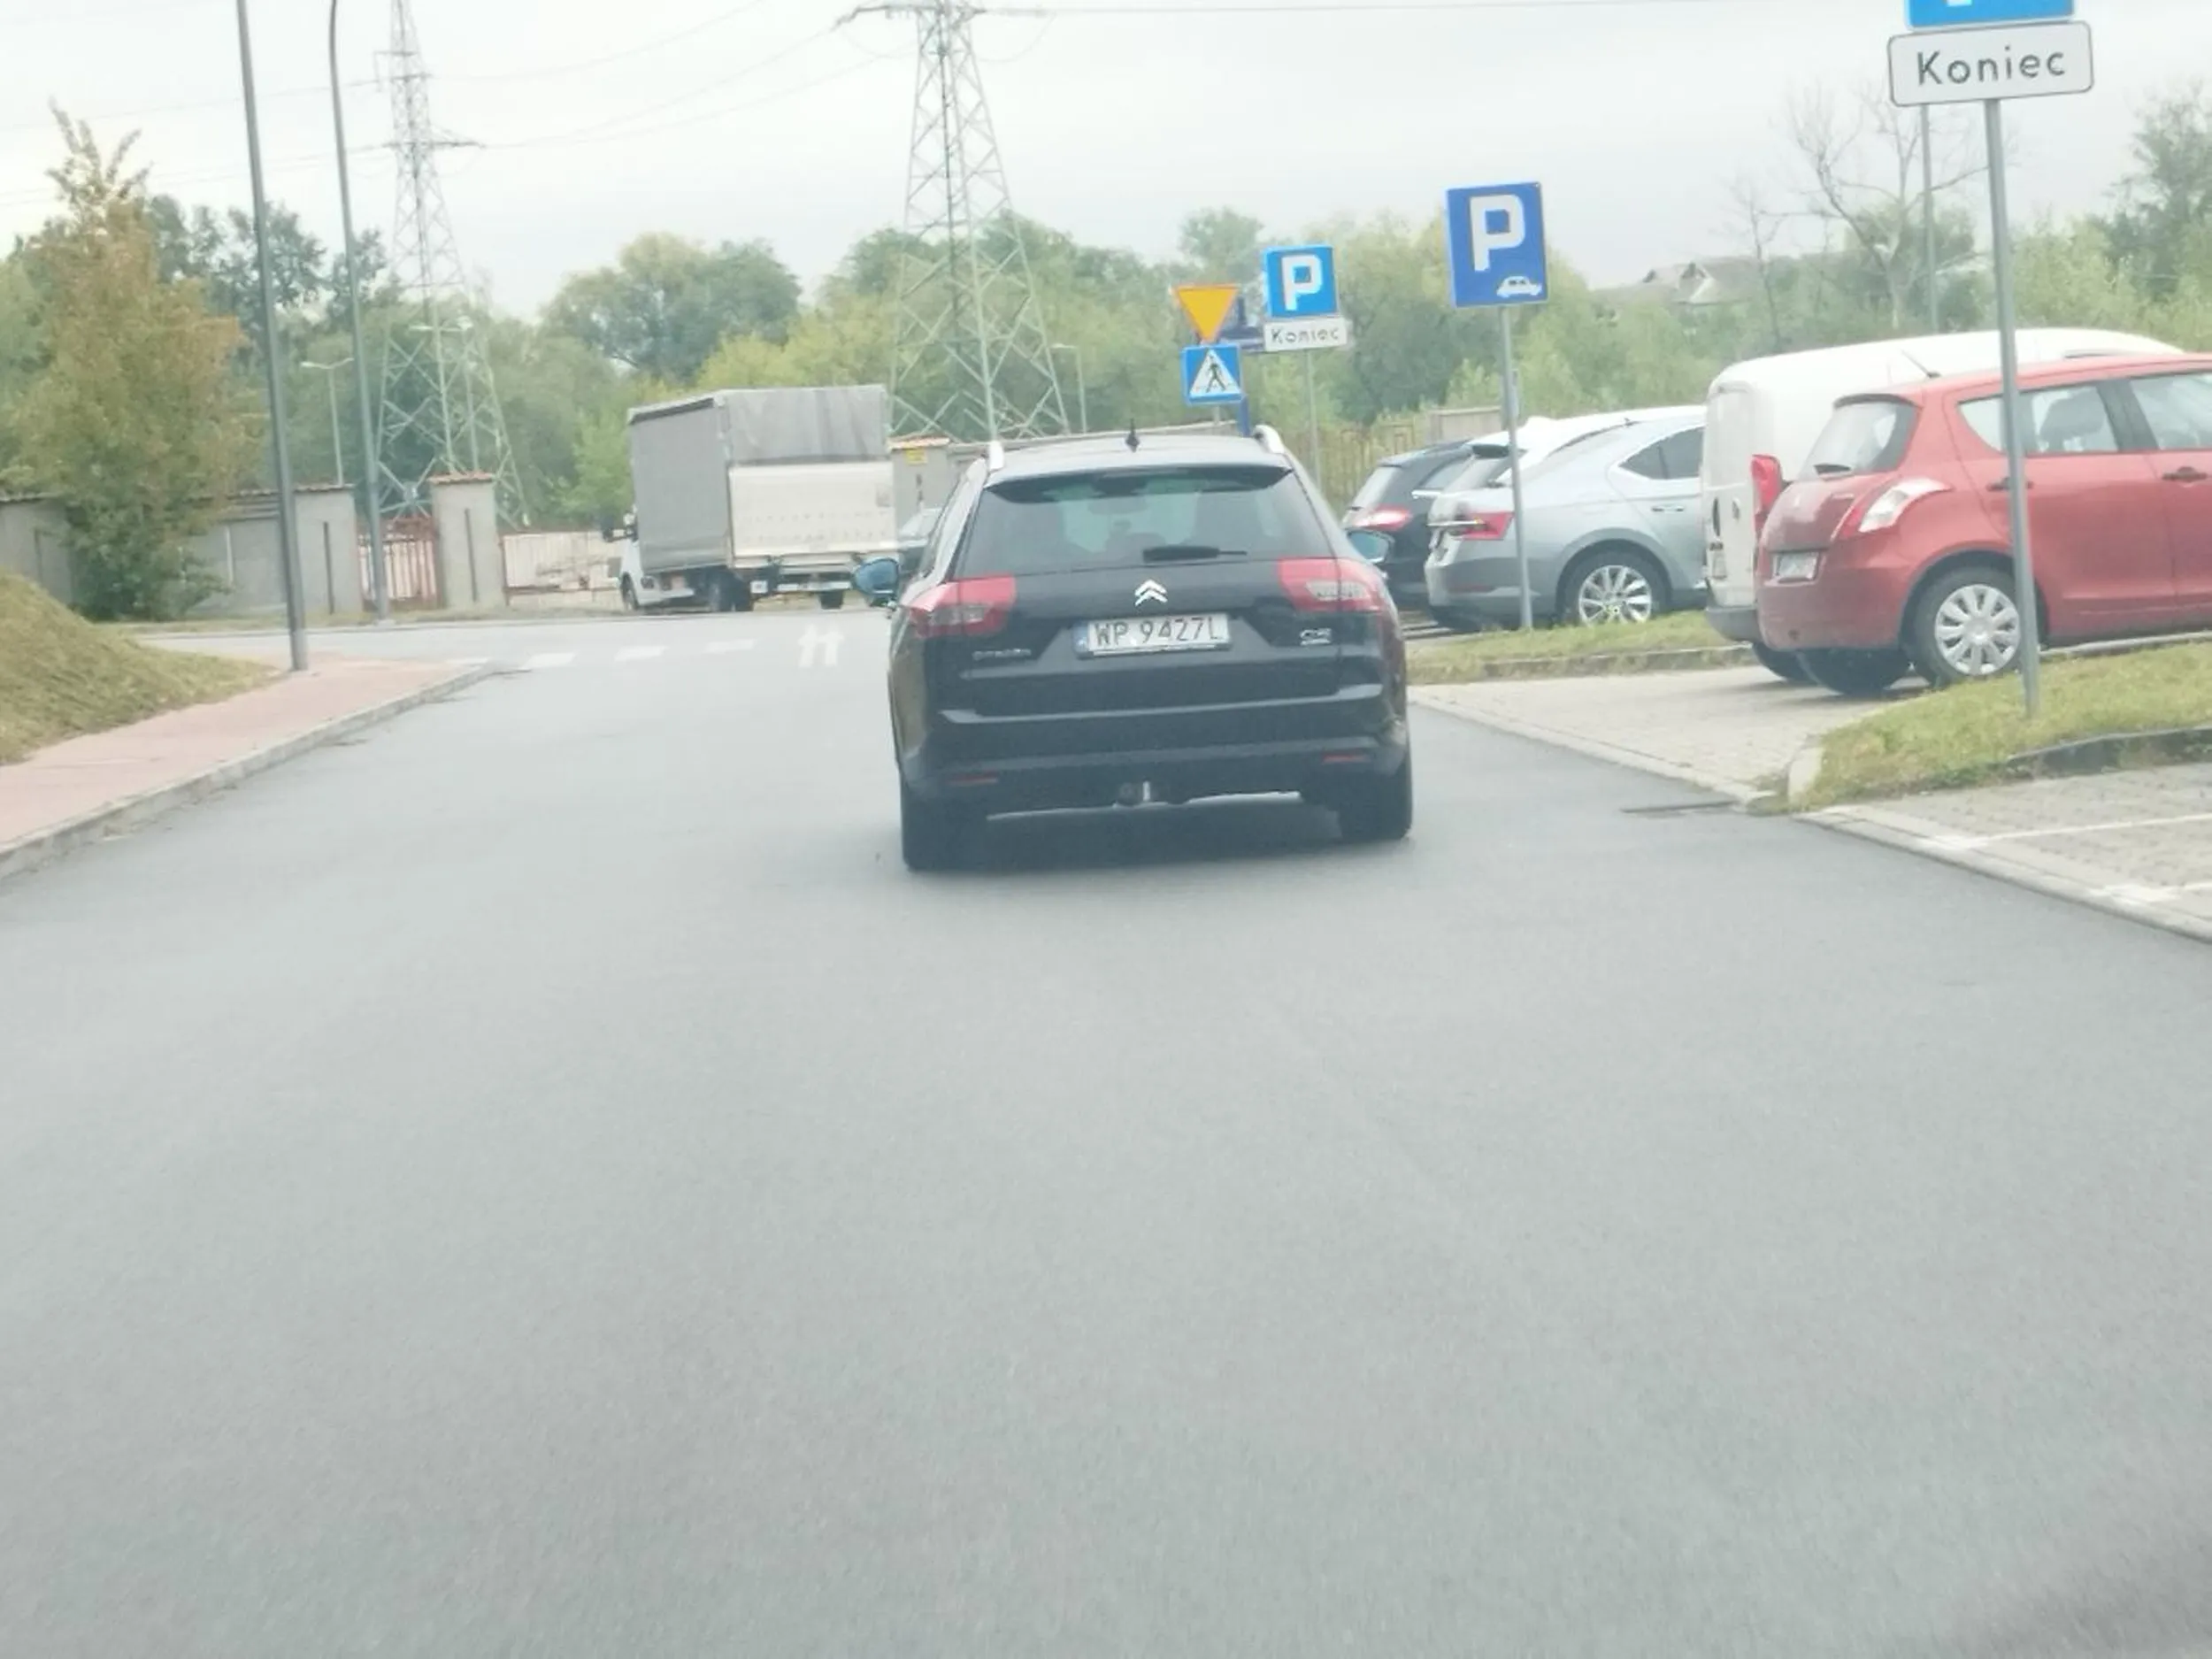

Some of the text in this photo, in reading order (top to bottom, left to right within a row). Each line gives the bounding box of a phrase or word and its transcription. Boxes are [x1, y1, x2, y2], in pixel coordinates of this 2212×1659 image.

[1916, 44, 2066, 86] Koniec
[1470, 194, 1525, 272] P
[1281, 255, 1323, 311] P
[1271, 326, 1340, 345] Koniec
[1094, 617, 1219, 647] WP 9427L
